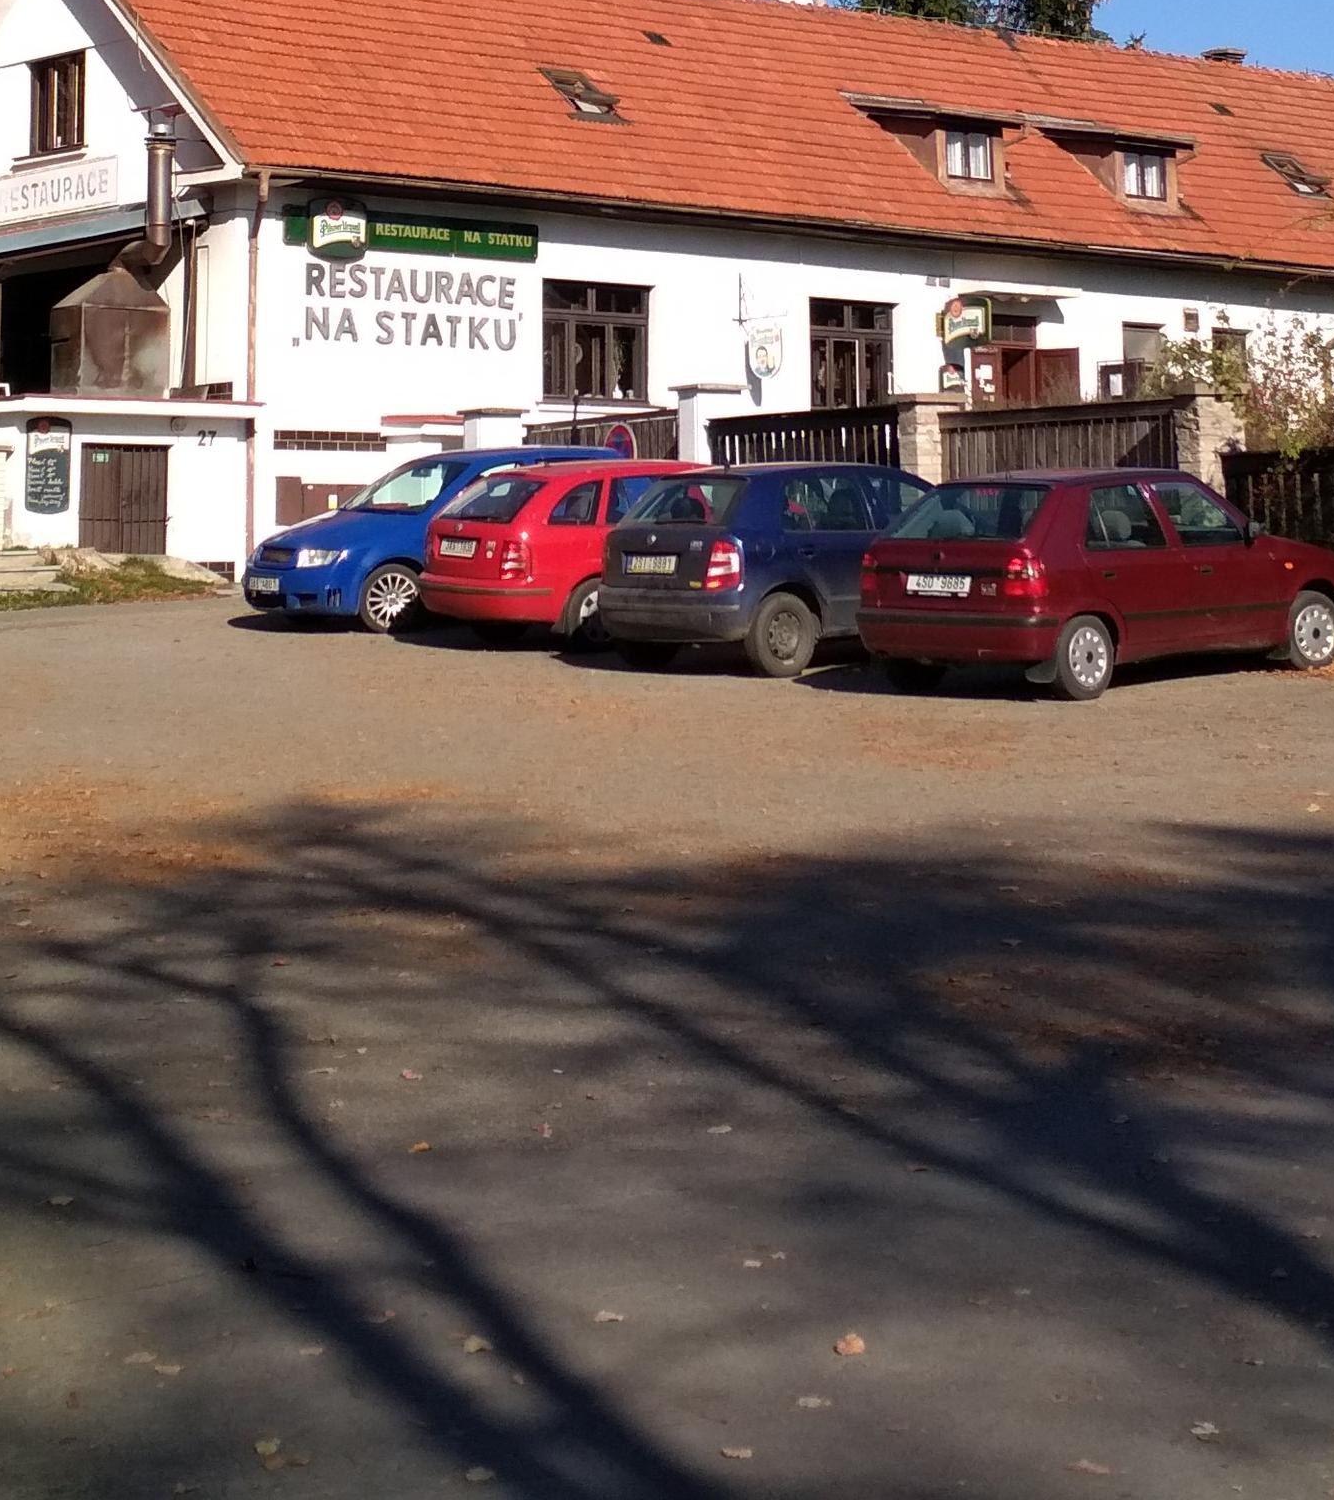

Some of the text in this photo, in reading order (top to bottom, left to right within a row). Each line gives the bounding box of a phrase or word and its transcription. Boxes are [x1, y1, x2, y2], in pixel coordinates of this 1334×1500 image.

[0, 168, 109, 213] ESTAURACE
[375, 223, 533, 248] RESTAURACE NA STATKU
[305, 262, 517, 311] RESTAURACE
[197, 429, 217, 447] 27
